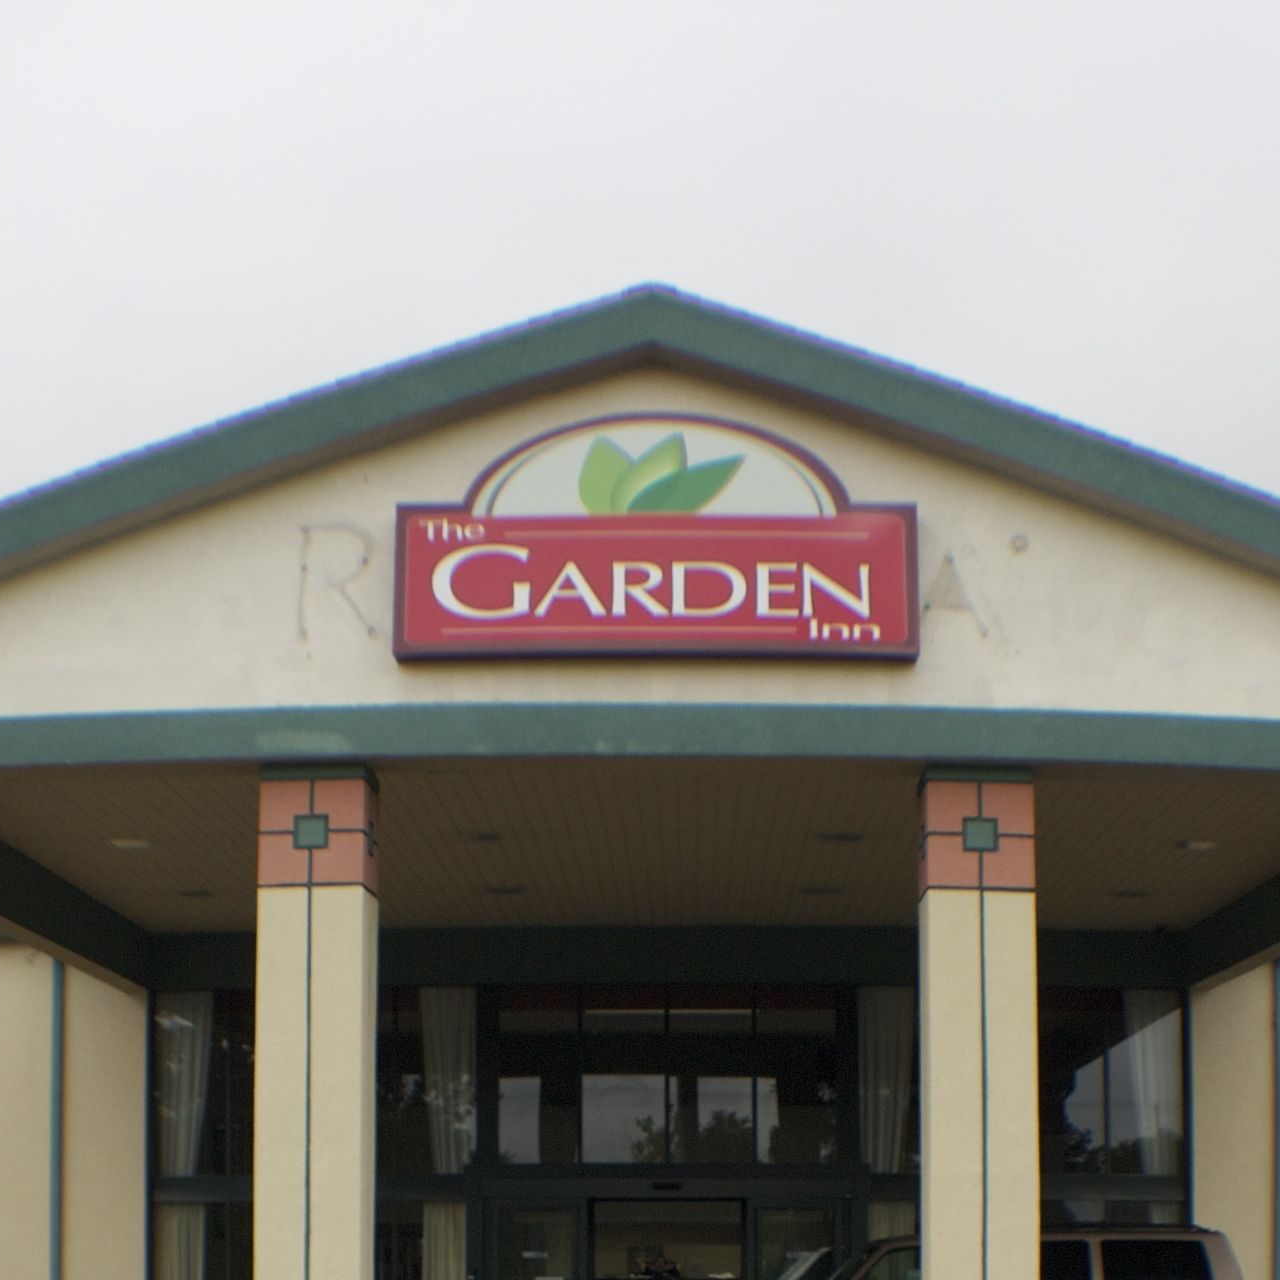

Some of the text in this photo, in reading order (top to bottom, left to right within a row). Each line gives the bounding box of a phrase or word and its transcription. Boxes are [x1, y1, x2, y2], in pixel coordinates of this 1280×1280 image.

[418, 517, 486, 543] The
[431, 543, 870, 623] GARDEN
[809, 617, 880, 641] Inn
